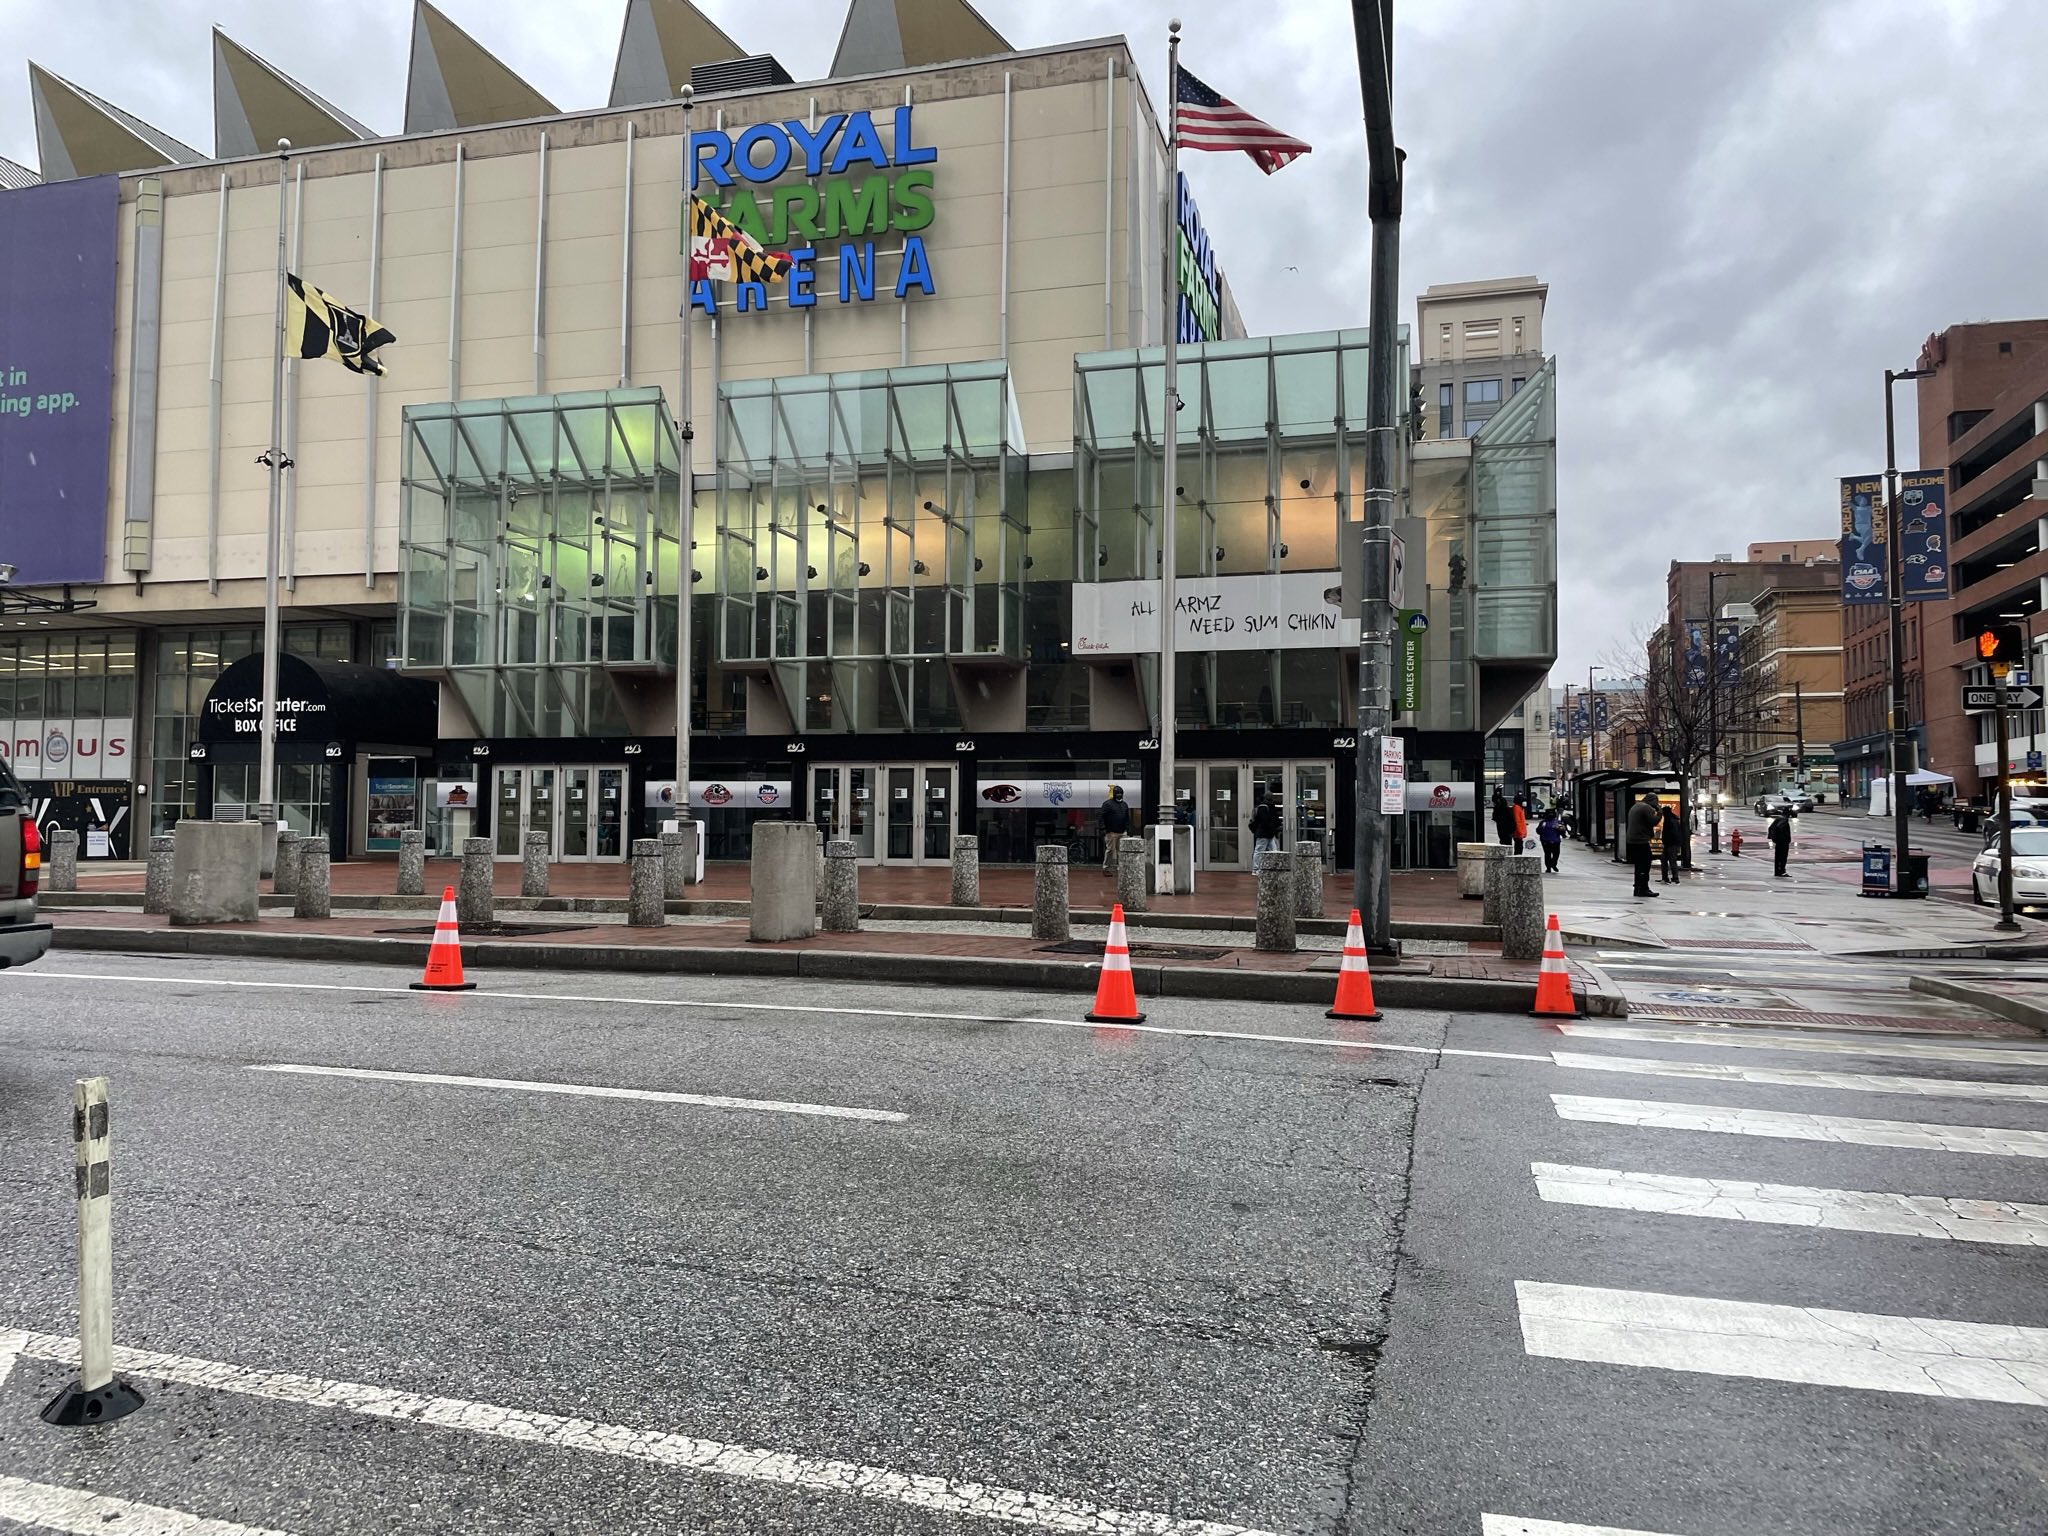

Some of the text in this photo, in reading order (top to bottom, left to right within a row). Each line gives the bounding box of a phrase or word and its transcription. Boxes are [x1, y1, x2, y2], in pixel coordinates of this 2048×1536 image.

[683, 105, 938, 191] ROYAL
[9, 366, 27, 386] in
[37, 392, 80, 414] app.
[1856, 482, 1882, 493] NEW
[1902, 476, 1945, 487] WELCOME
[1842, 484, 1852, 534] CREATING
[1872, 495, 1883, 544] LEGACIES
[1131, 600, 1157, 617] ALL
[1190, 613, 1337, 634] NEED SUM CHIKIN
[1406, 640, 1415, 708] CHARLES CENTER
[1971, 693, 2021, 703] ONE AY
[235, 719, 297, 732] BOX FICE
[53, 781, 127, 797] VIP Entrance
